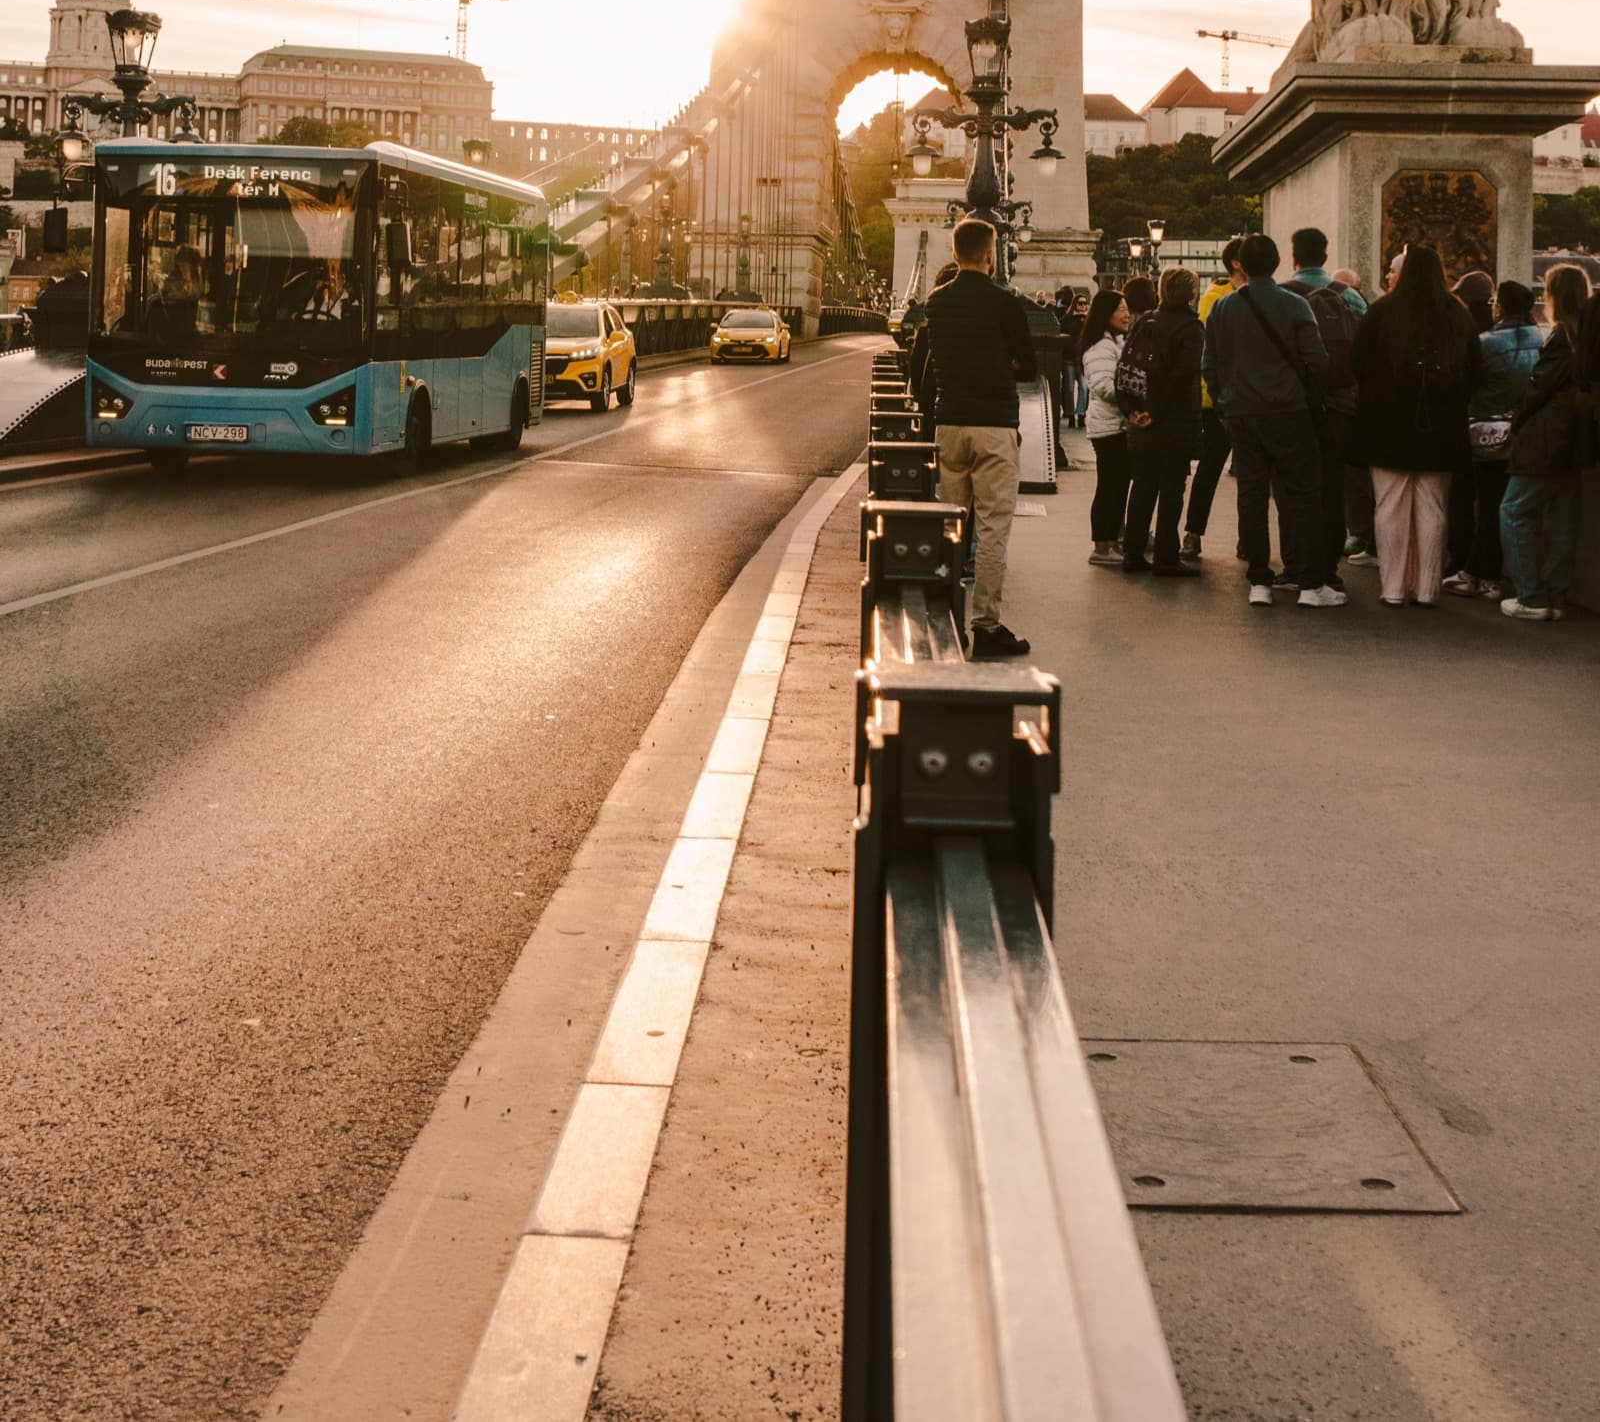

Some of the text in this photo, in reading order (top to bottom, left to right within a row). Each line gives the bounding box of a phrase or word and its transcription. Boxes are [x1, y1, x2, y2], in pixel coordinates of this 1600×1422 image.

[150, 163, 176, 196] 16
[204, 165, 312, 180] Deák Ferenc
[238, 180, 279, 196] tér M
[193, 427, 245, 439] NCV-298
